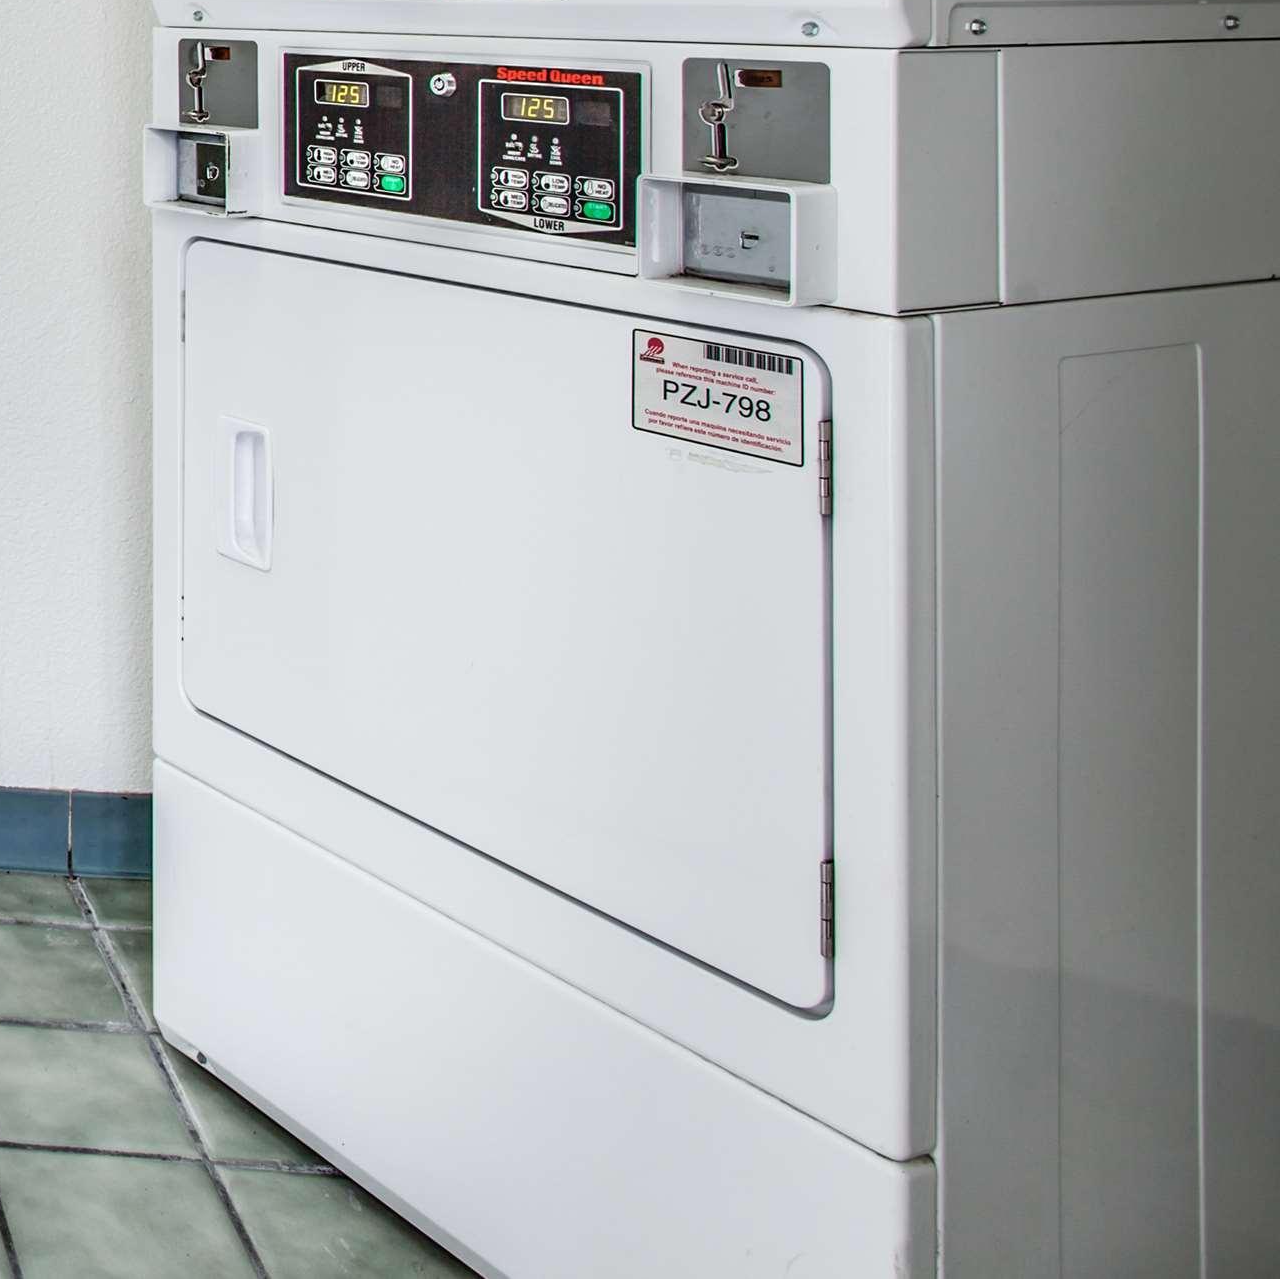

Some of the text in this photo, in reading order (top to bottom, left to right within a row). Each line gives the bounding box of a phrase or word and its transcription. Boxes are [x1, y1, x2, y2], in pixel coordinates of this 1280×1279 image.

[342, 62, 365, 72] UPPER
[497, 67, 604, 85] Speed Queen
[332, 84, 360, 103] 125
[520, 97, 555, 119] 125
[533, 218, 565, 232] LOWER
[672, 361, 688, 369] When
[689, 366, 716, 376] reporting
[722, 372, 744, 380] service
[675, 371, 702, 380] reference
[715, 379, 740, 388] machine
[663, 379, 770, 421] PZJ-798
